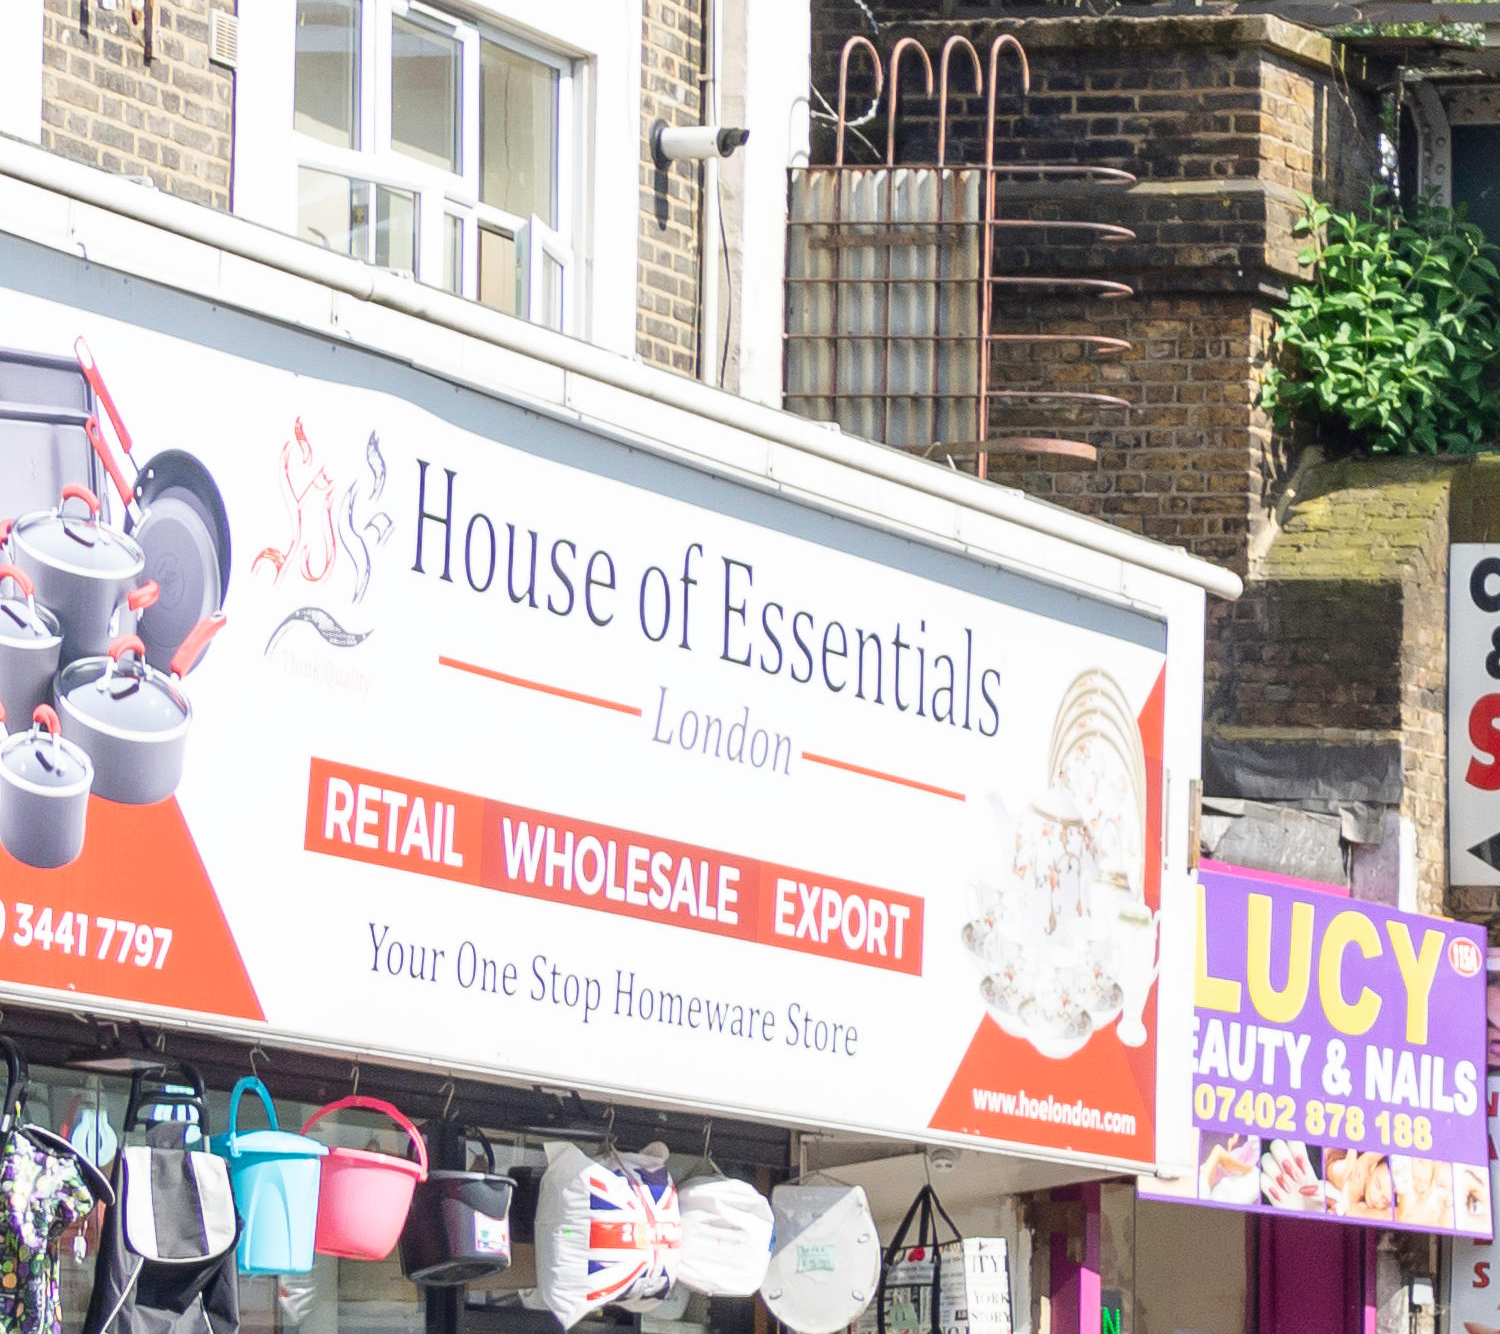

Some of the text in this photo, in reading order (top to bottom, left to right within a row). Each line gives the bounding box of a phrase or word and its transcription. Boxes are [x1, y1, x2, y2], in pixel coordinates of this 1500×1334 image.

[412, 458, 1001, 738] House of Essentials
[651, 686, 793, 775] London
[323, 776, 912, 960] RETAIL WHOLESALE EXPORT
[13, 903, 89, 957] 3441
[96, 917, 173, 970] 7797
[1195, 883, 1446, 1045] LUCY
[368, 922, 858, 1057] Your One Stop Homeware Store
[973, 1085, 1136, 1135] www.hoelondon.com
[1194, 1083, 1433, 1151] 07402 878 188
[1322, 1043, 1351, 1098] &
[1365, 1046, 1478, 1116] NAILS
